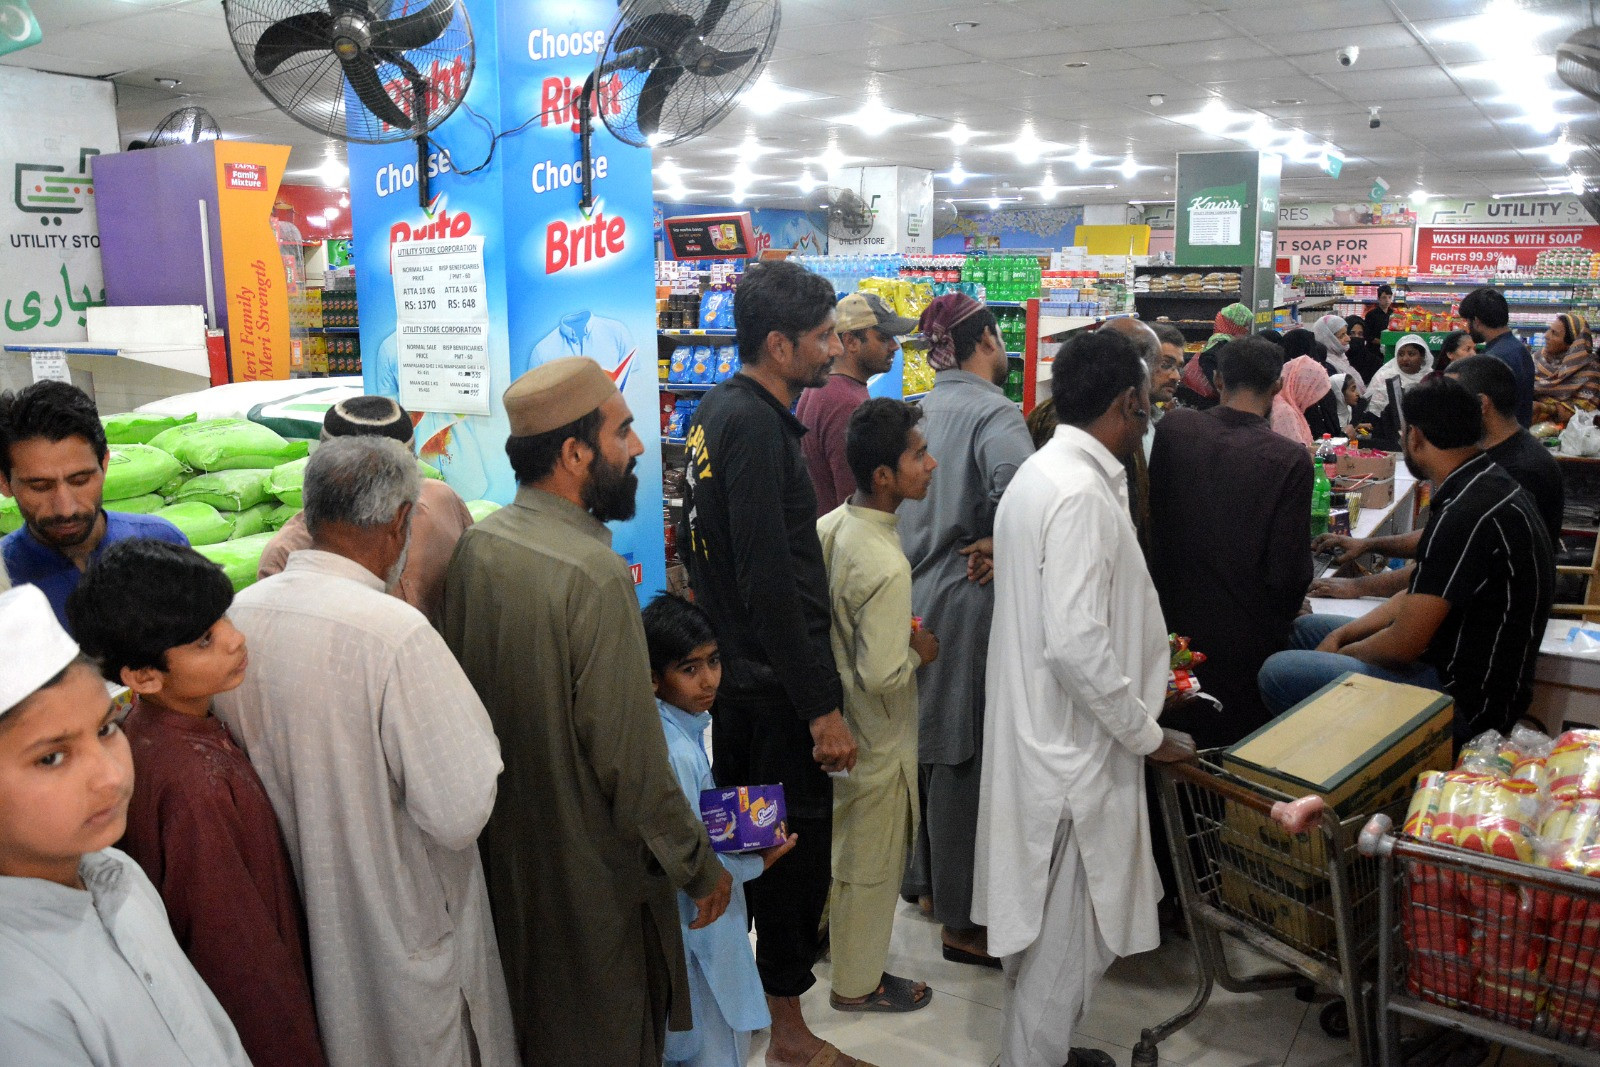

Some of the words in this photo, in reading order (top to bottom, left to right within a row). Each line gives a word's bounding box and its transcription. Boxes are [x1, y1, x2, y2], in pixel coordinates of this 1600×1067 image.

[528, 28, 605, 60] Choose
[232, 170, 259, 180] Family
[231, 178, 262, 187] Mixture
[1279, 208, 1309, 221] RES
[1487, 202, 1562, 217] UTILITY
[11, 234, 67, 248] UTILITY
[72, 234, 101, 248] STO
[545, 213, 625, 275] Brite
[863, 237, 885, 245] STORE
[1432, 234, 1466, 244] WASH
[1469, 234, 1510, 244] HANDS
[1514, 233, 1545, 244] WITH
[1549, 233, 1583, 244] SOAP
[397, 247, 419, 256] UTILITY
[419, 246, 436, 255] STORE
[437, 244, 477, 254] CORPORATION
[1292, 240, 1332, 251] SOAP
[1337, 239, 1368, 251] FOR
[1300, 255, 1321, 266] NG
[1430, 252, 1466, 261] FIGHTS
[1468, 251, 1504, 262] 99.9%
[1429, 264, 1480, 274] BACTERIA
[403, 287, 418, 295] ATTA
[469, 285, 478, 293] KG
[251, 259, 272, 332] Strength
[404, 300, 416, 310] RS:
[418, 299, 437, 310] 1370
[448, 299, 460, 309] RS:
[462, 298, 476, 309] 648
[236, 286, 256, 346] Family
[402, 326, 422, 334] UTILITY
[423, 325, 440, 333] STORE
[441, 326, 482, 334] CORPORATION
[258, 336, 274, 379] Meri
